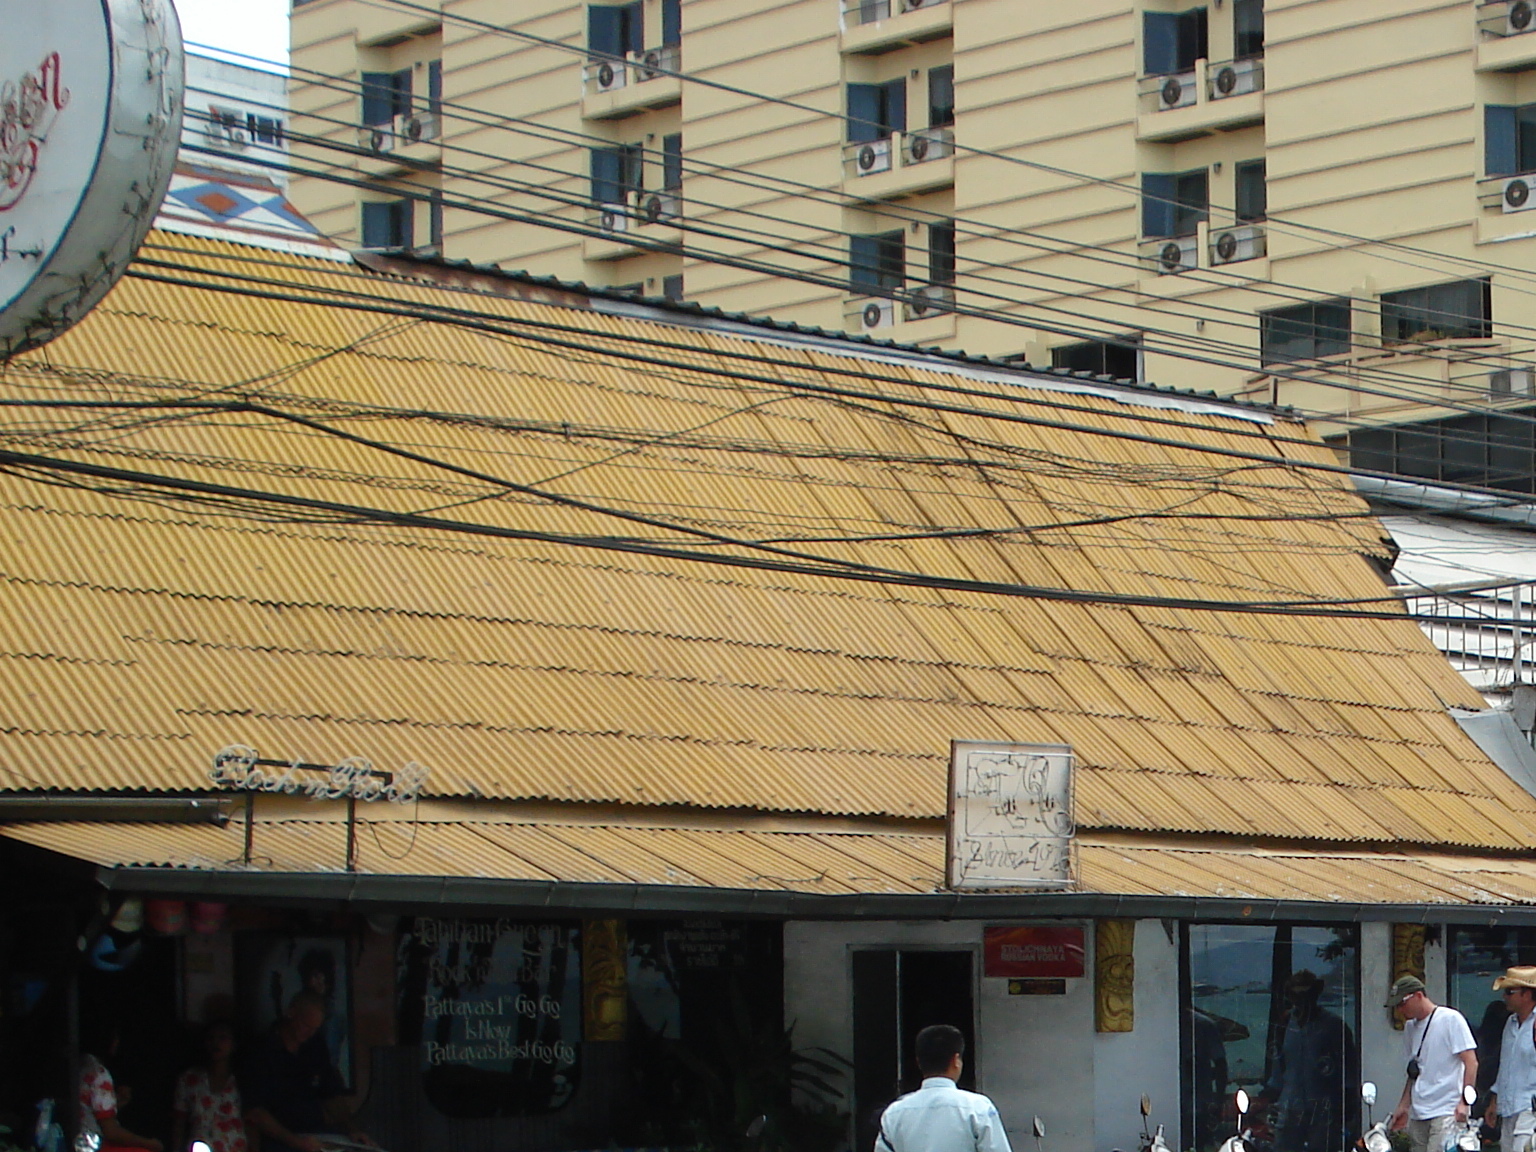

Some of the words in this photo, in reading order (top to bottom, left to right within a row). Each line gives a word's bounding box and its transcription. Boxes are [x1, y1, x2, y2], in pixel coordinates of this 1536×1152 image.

[515, 994, 537, 1019] Go
[539, 994, 561, 1019] Go
[532, 1041, 553, 1064] Go
[553, 1041, 576, 1065] Go
